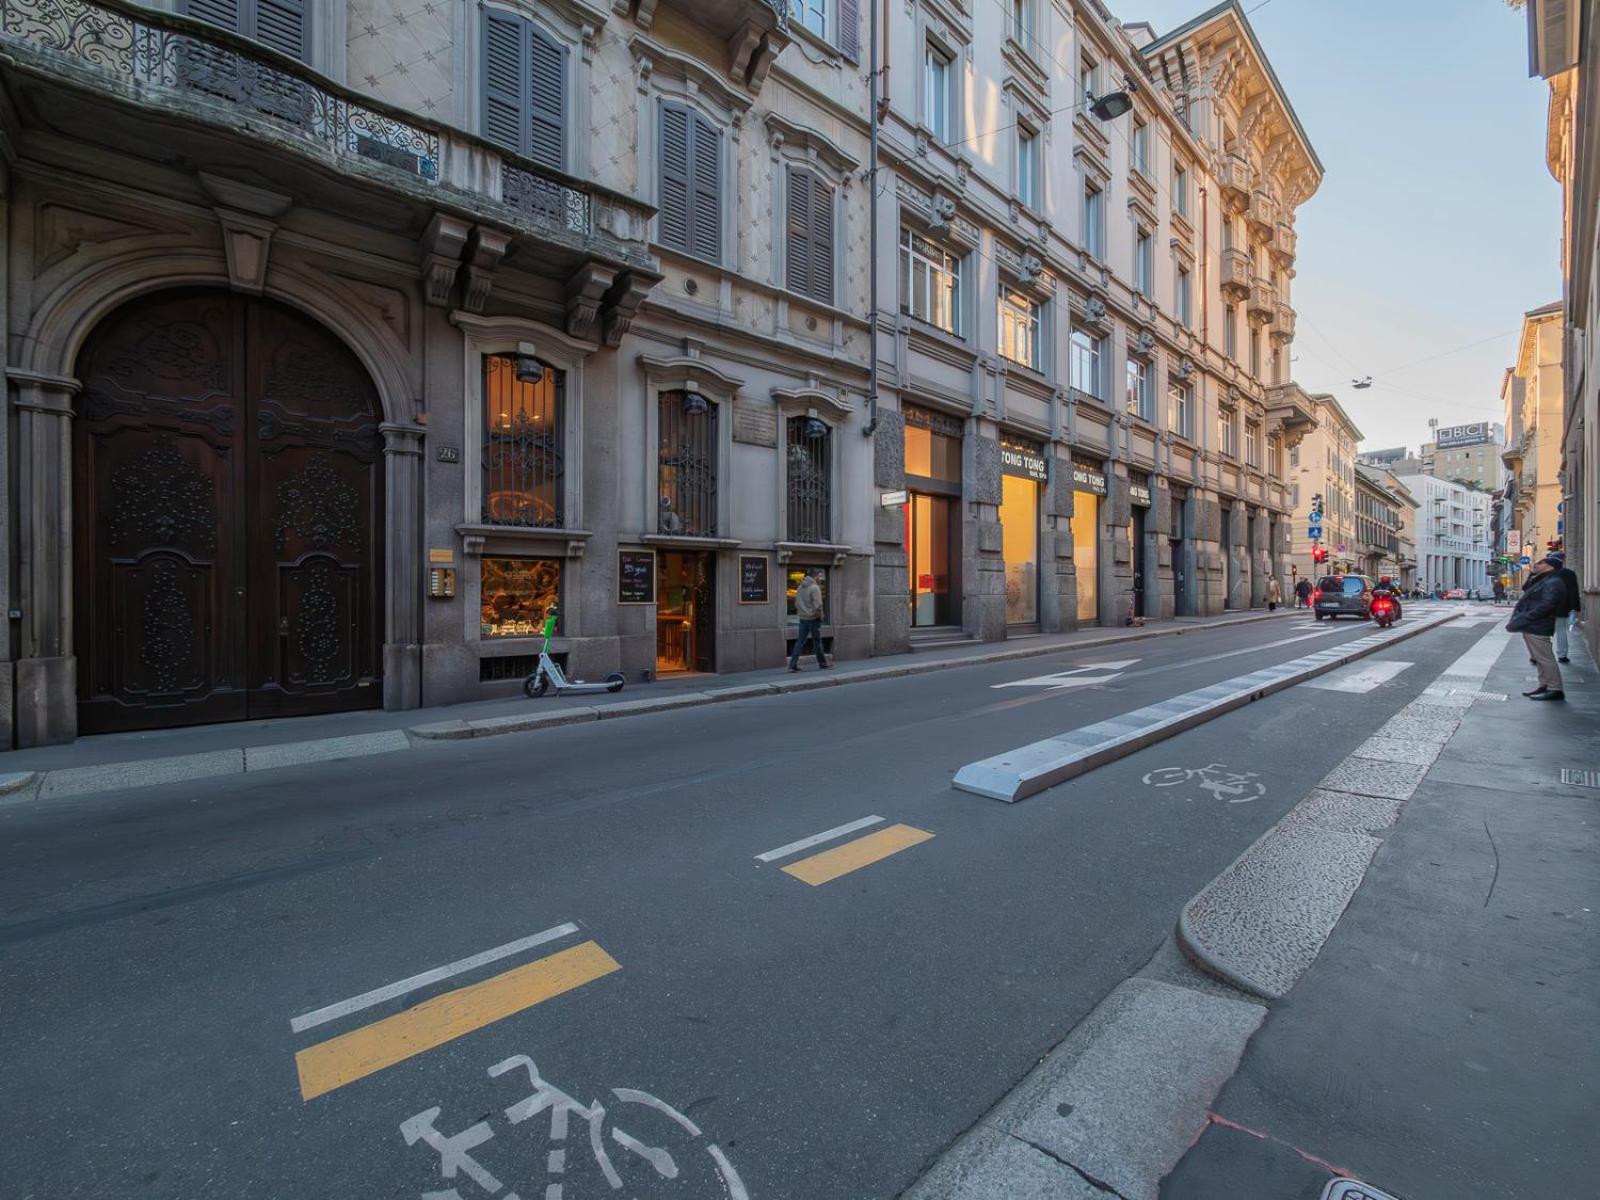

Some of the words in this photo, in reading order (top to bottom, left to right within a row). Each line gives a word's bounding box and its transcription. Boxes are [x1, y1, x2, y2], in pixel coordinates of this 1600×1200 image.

[1001, 451, 1022, 466] TONG
[1024, 456, 1044, 471] TONG
[1073, 471, 1088, 483] ONG
[1088, 474, 1104, 487] TONG
